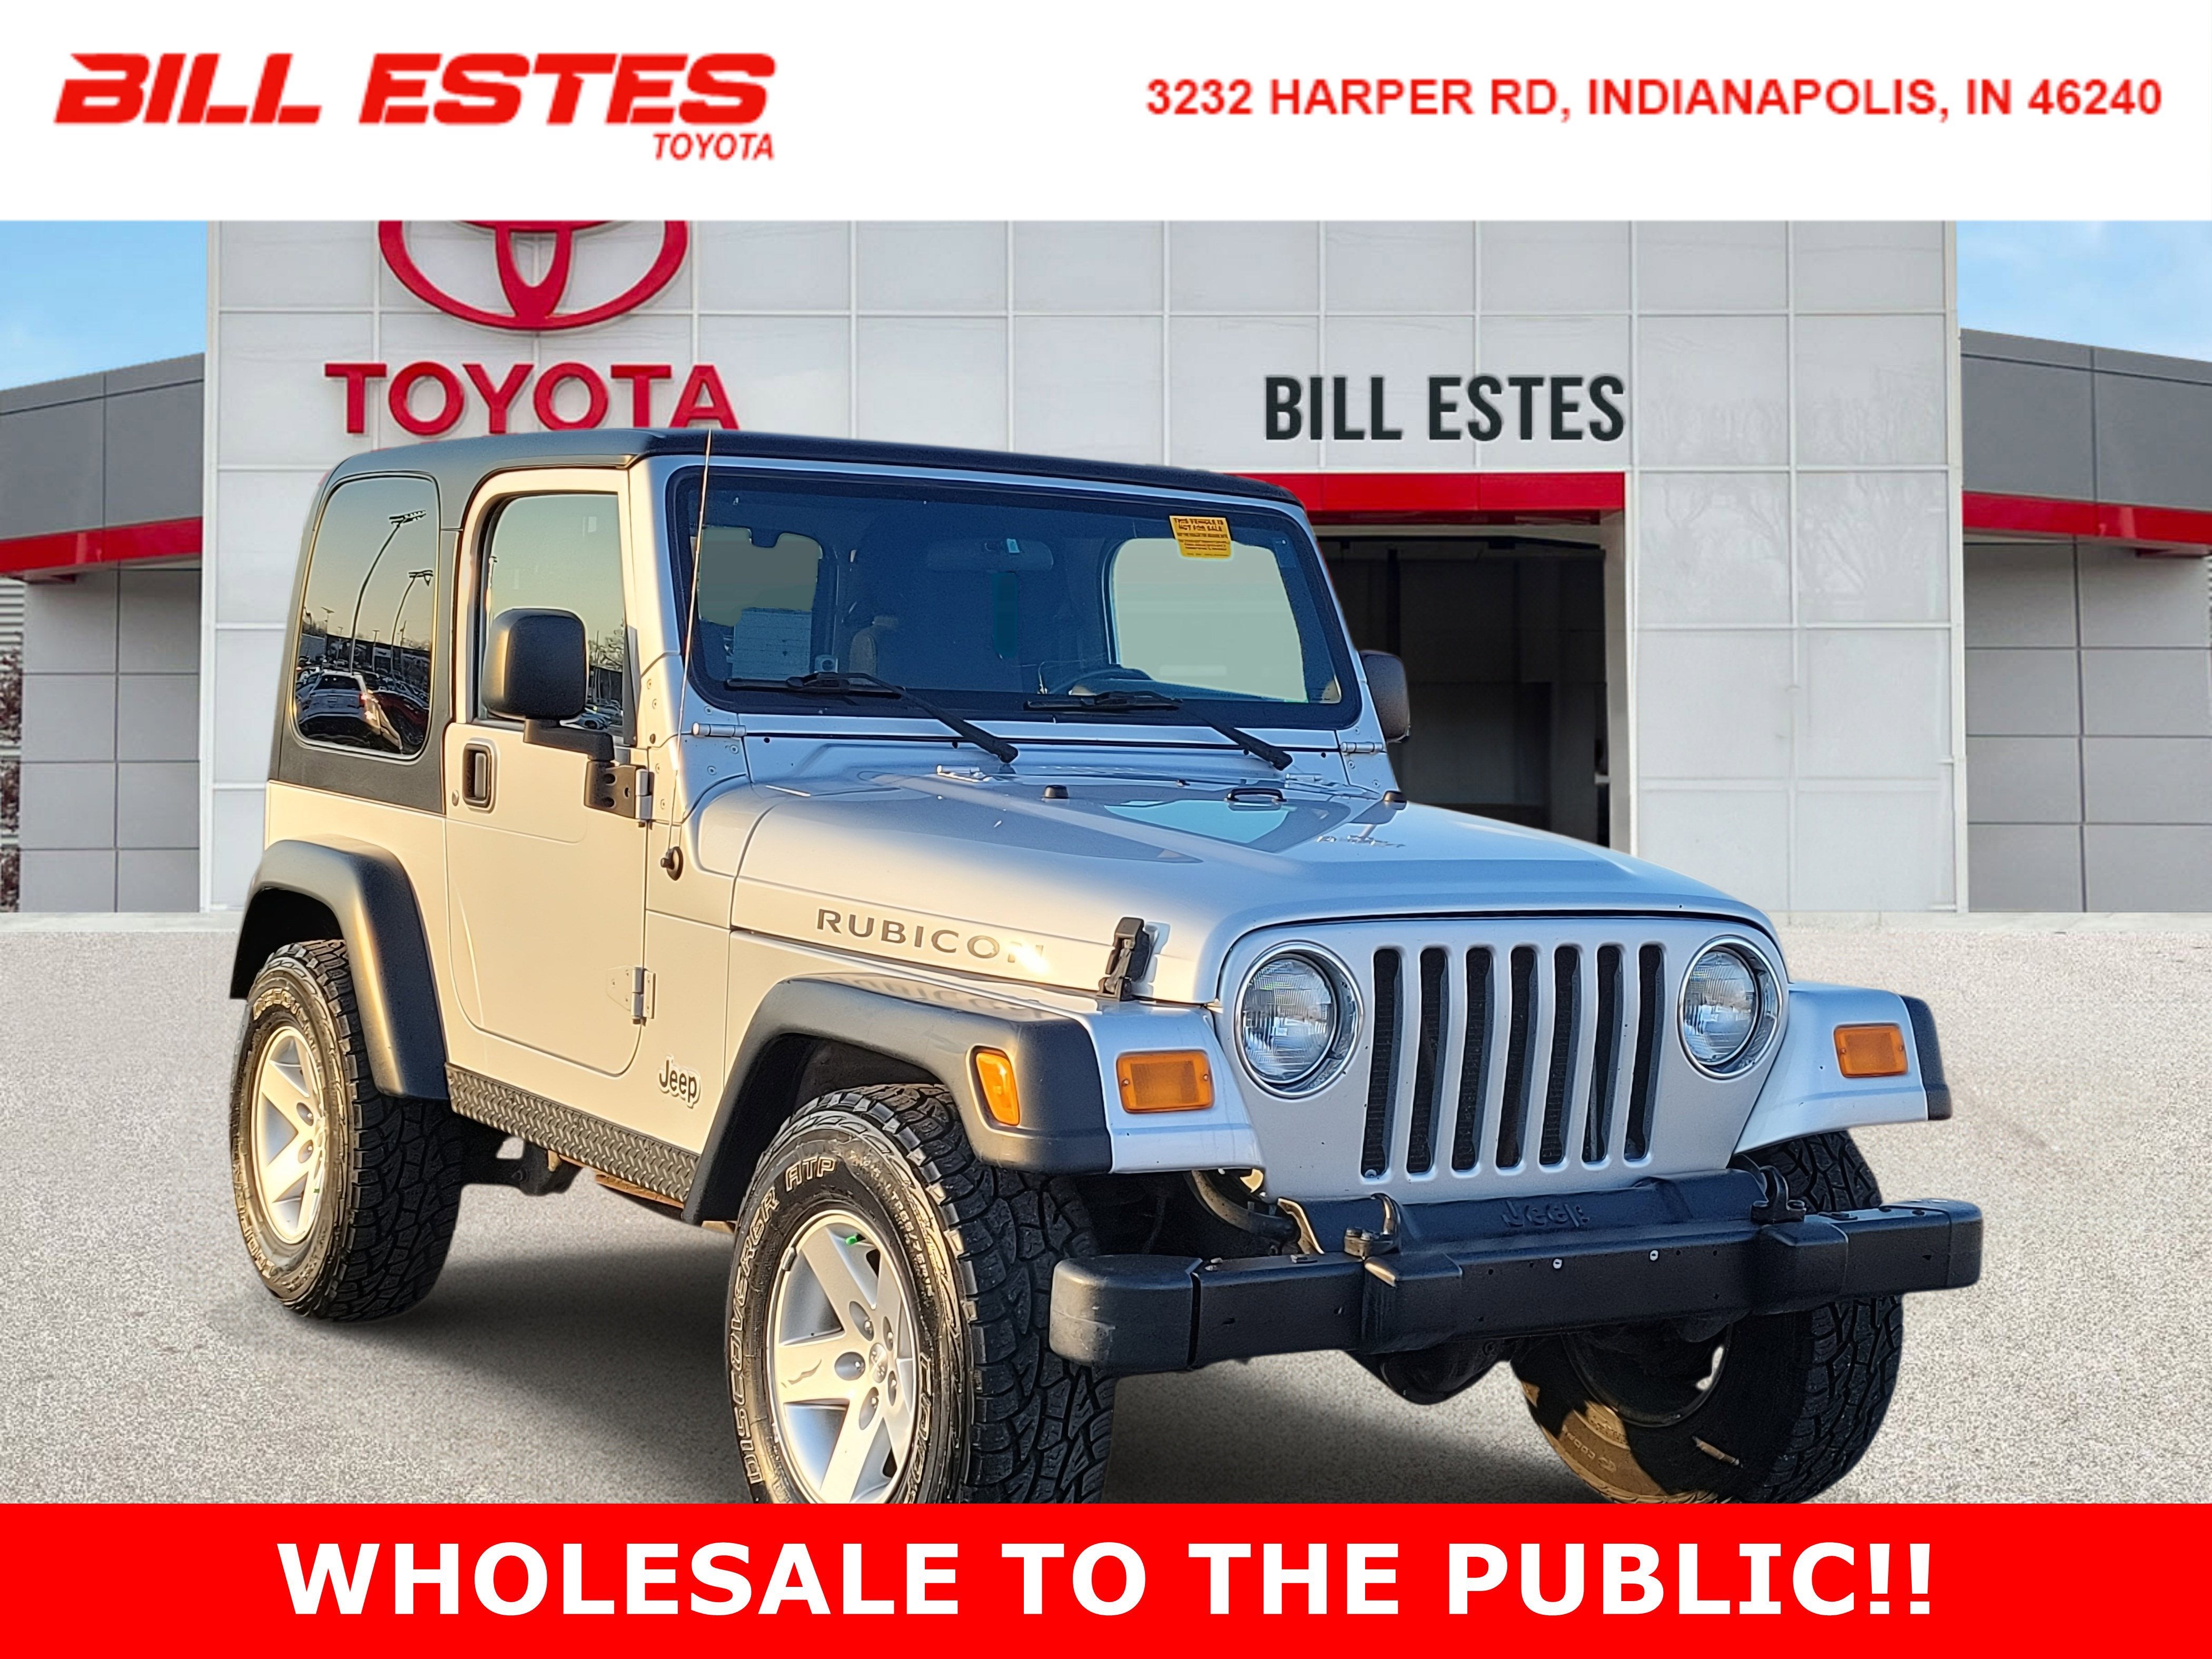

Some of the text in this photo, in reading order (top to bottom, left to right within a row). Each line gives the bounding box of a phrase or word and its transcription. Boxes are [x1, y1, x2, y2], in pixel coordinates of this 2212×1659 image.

[325, 361, 739, 437] TOYOTA
[1266, 375, 1624, 441] BILL ESTES
[816, 907, 1044, 965] RUBICON
[658, 1056, 700, 1108] Jeep
[785, 1157, 836, 1192] ATP
